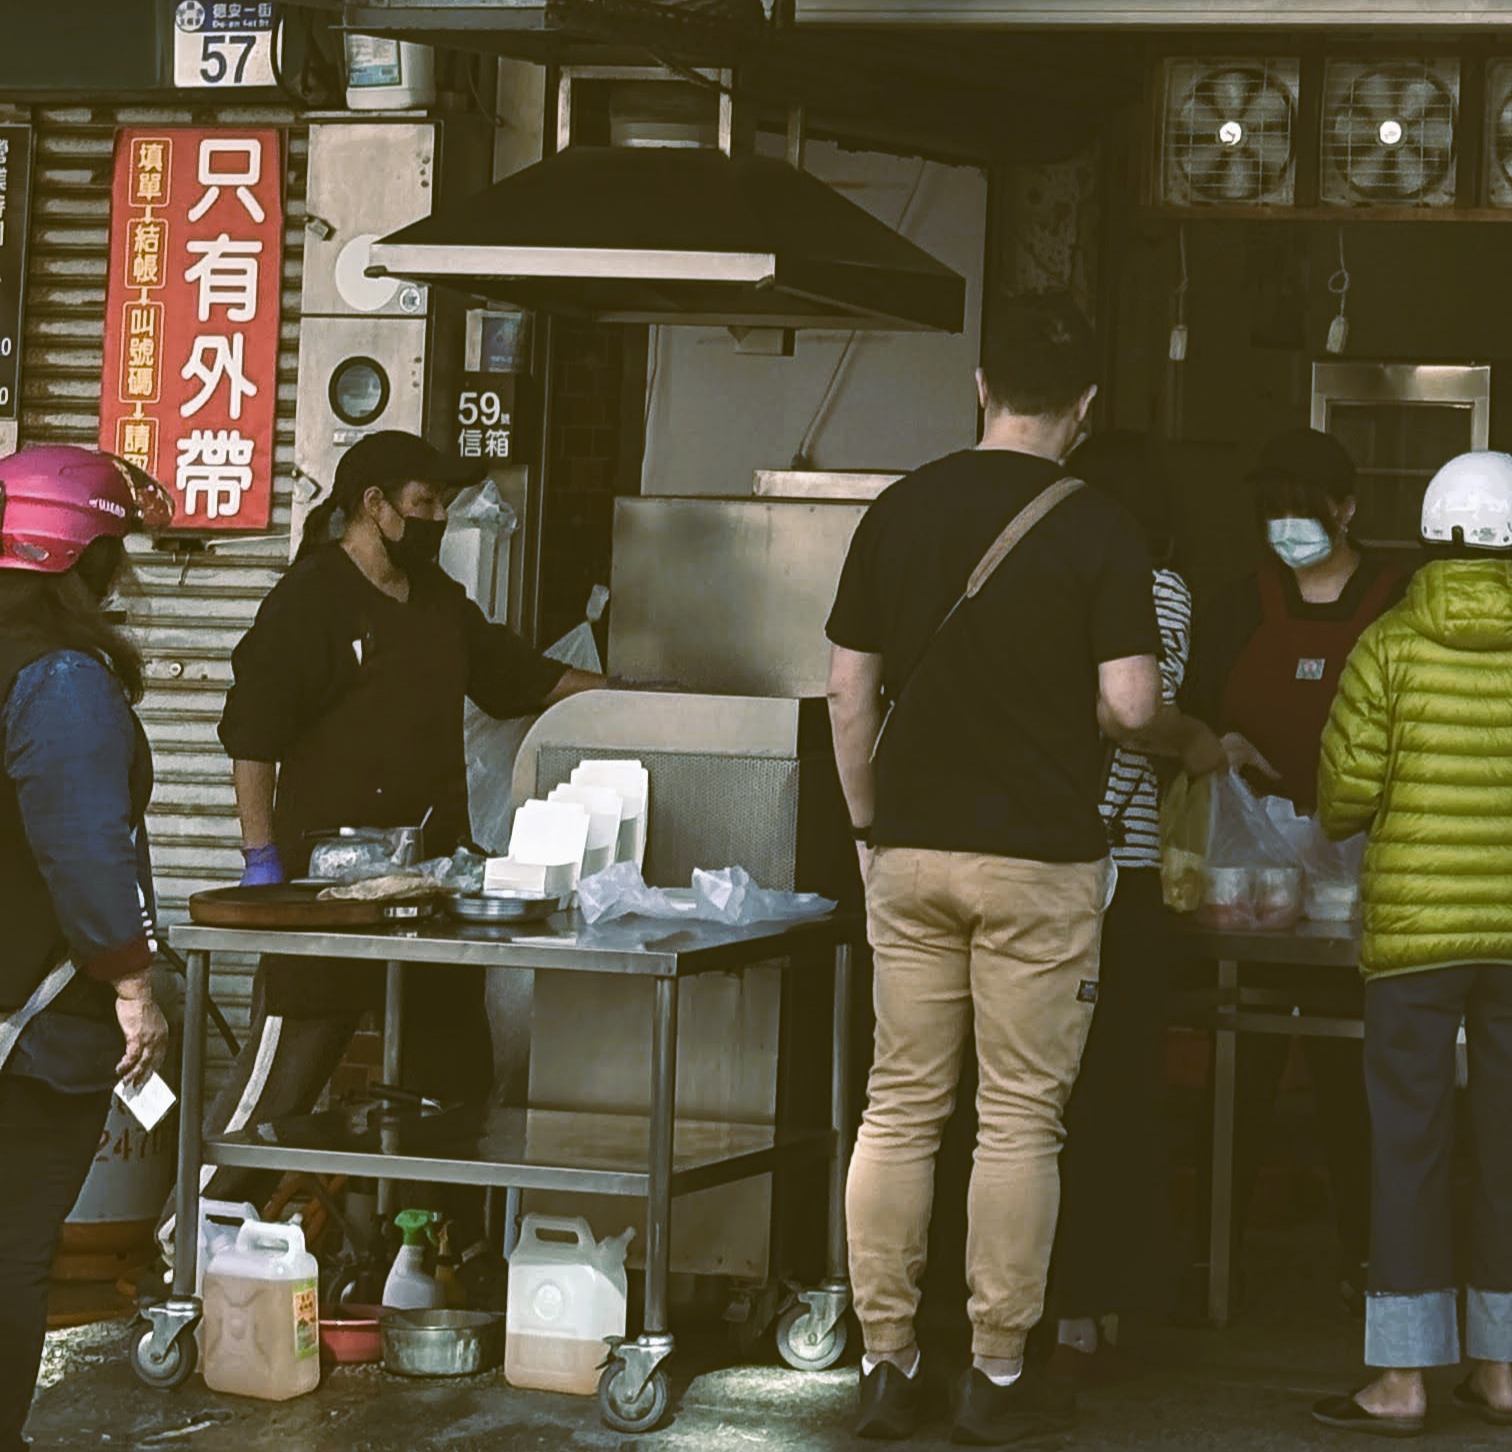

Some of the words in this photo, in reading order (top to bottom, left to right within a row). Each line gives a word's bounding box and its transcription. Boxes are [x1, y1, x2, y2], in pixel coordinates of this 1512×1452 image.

[200, 35, 257, 84] 57
[137, 143, 164, 201] 填單
[133, 226, 161, 283] 結帳
[127, 309, 155, 396] 叫號碼
[175, 137, 266, 520] 只有外帶
[458, 429, 510, 458] 信箱
